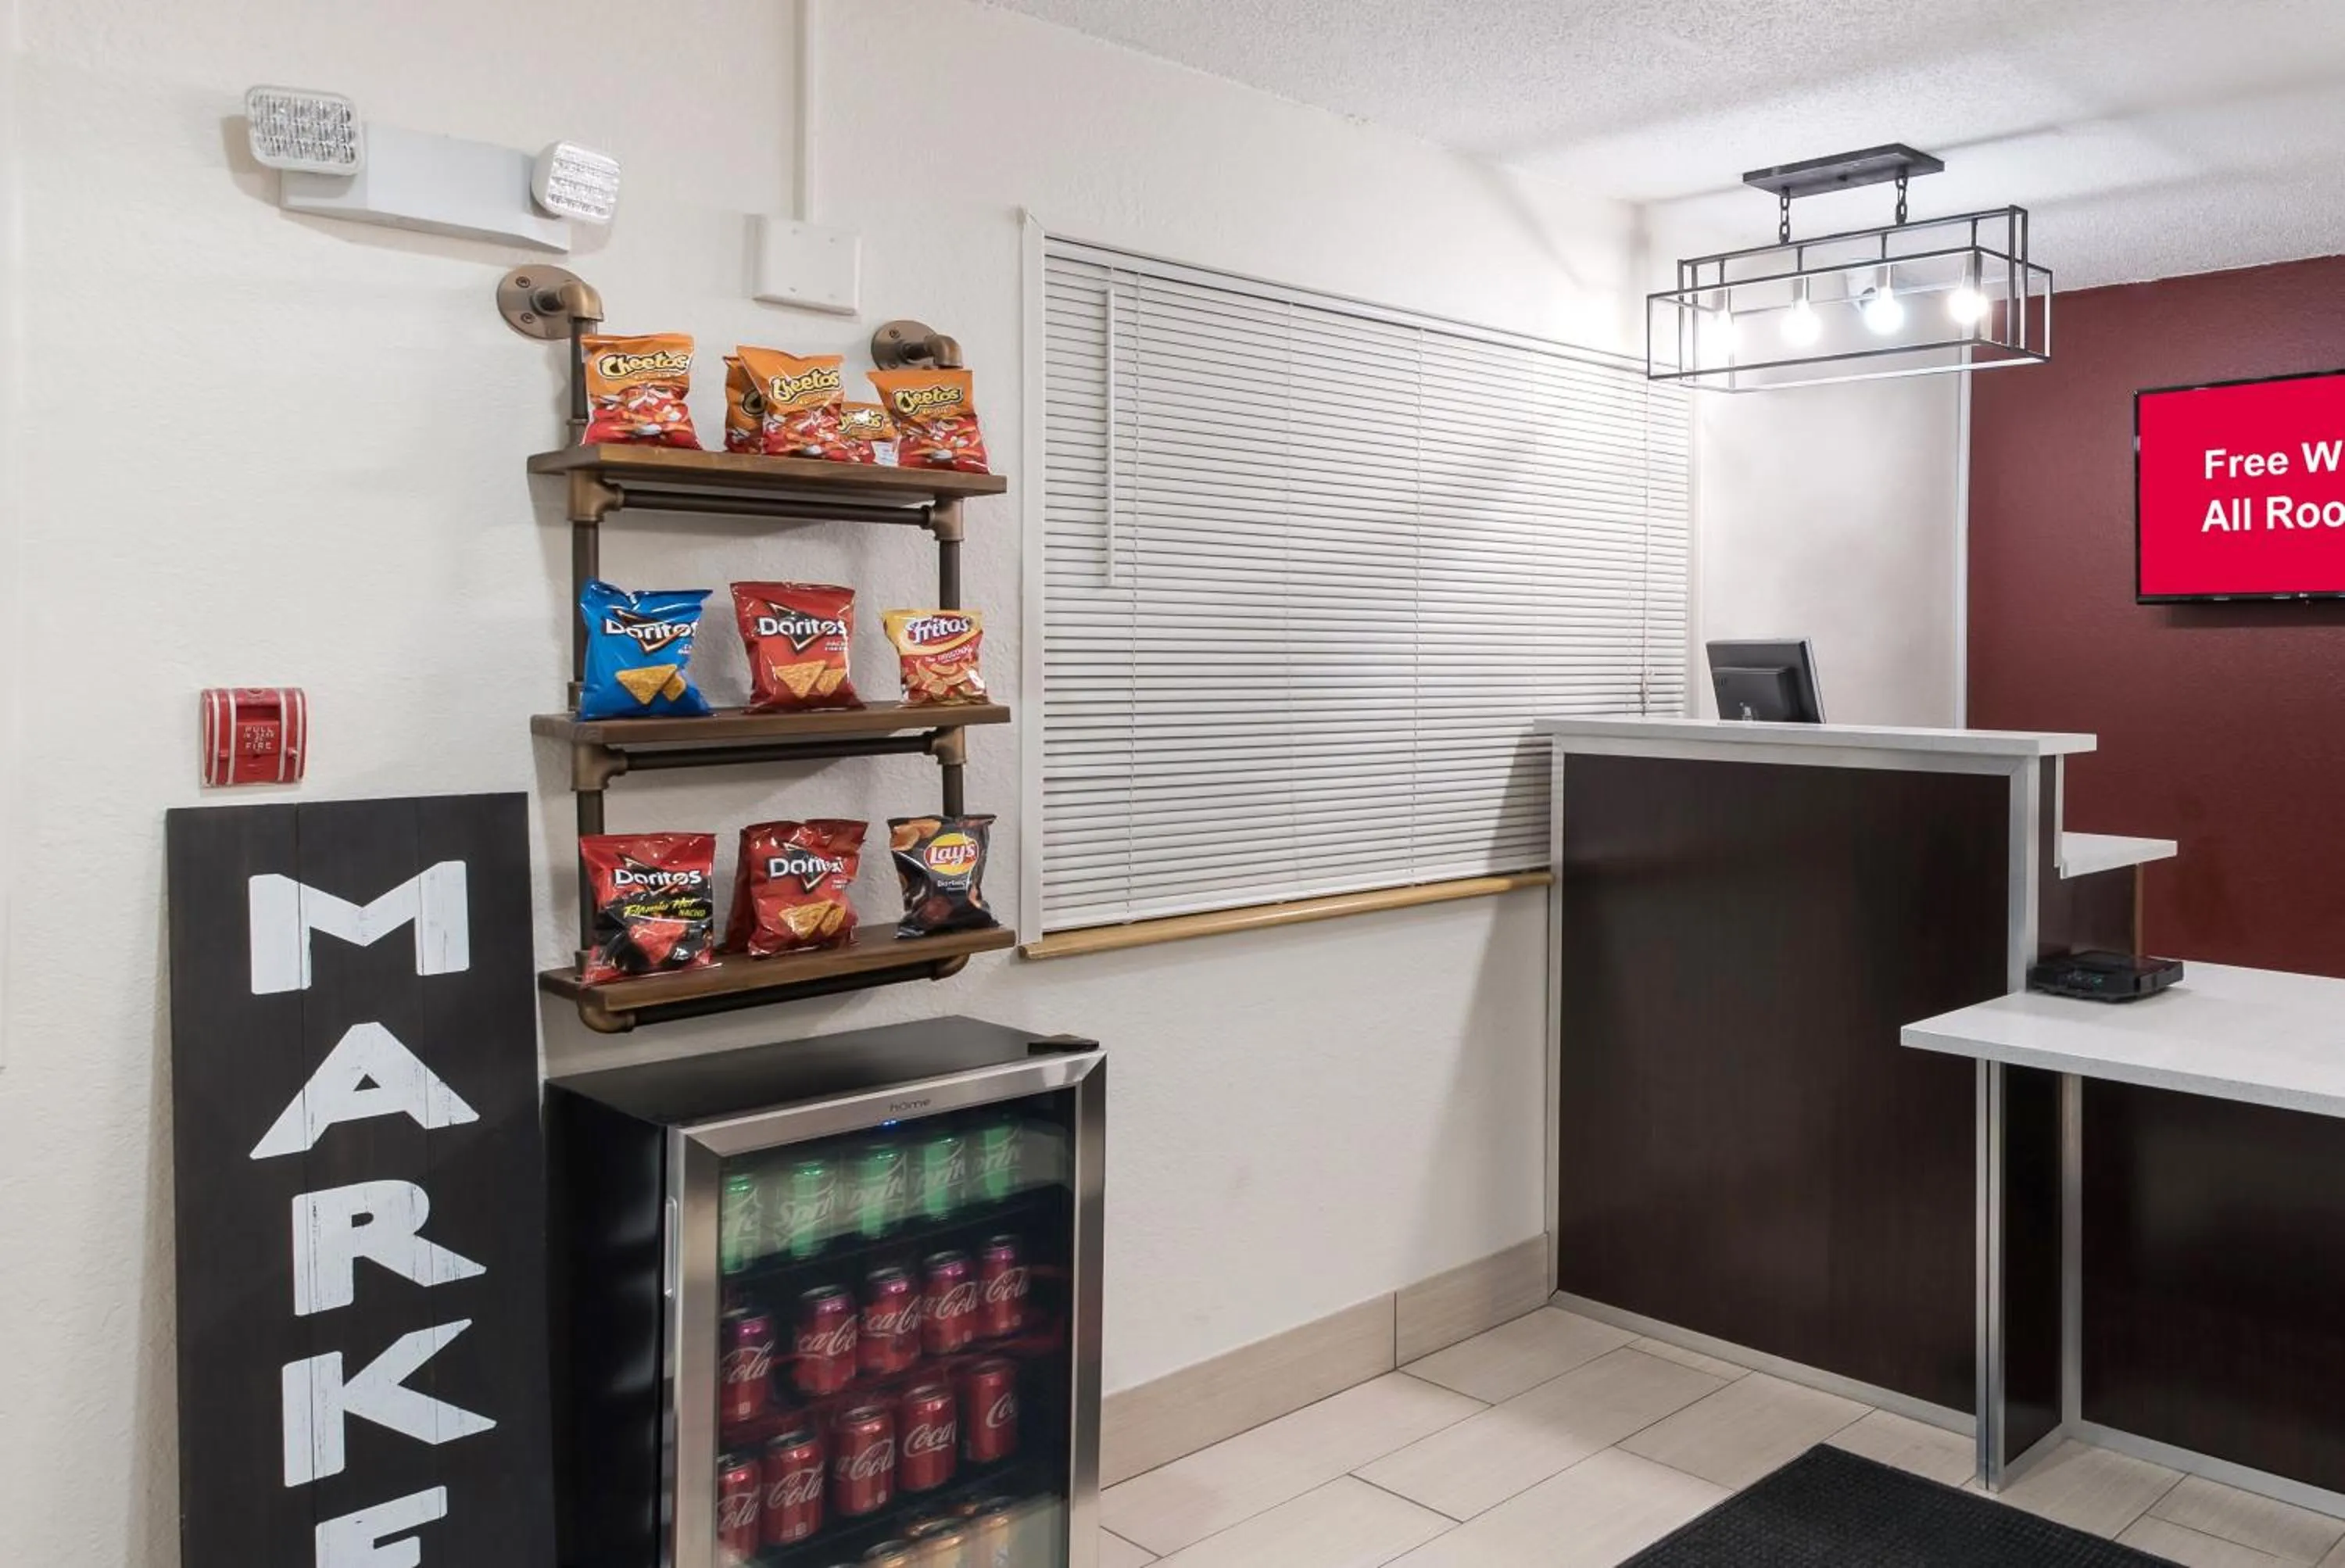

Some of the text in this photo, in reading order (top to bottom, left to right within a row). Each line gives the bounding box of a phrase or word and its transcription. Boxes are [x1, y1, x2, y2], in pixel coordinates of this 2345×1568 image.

[600, 352, 689, 377] Cheetos
[2204, 449, 2290, 479] Free
[2201, 498, 2252, 532] All
[758, 617, 847, 636] Doritos
[905, 617, 971, 644] Fritos
[614, 868, 703, 886] Doritos
[890, 1099, 932, 1112] home
